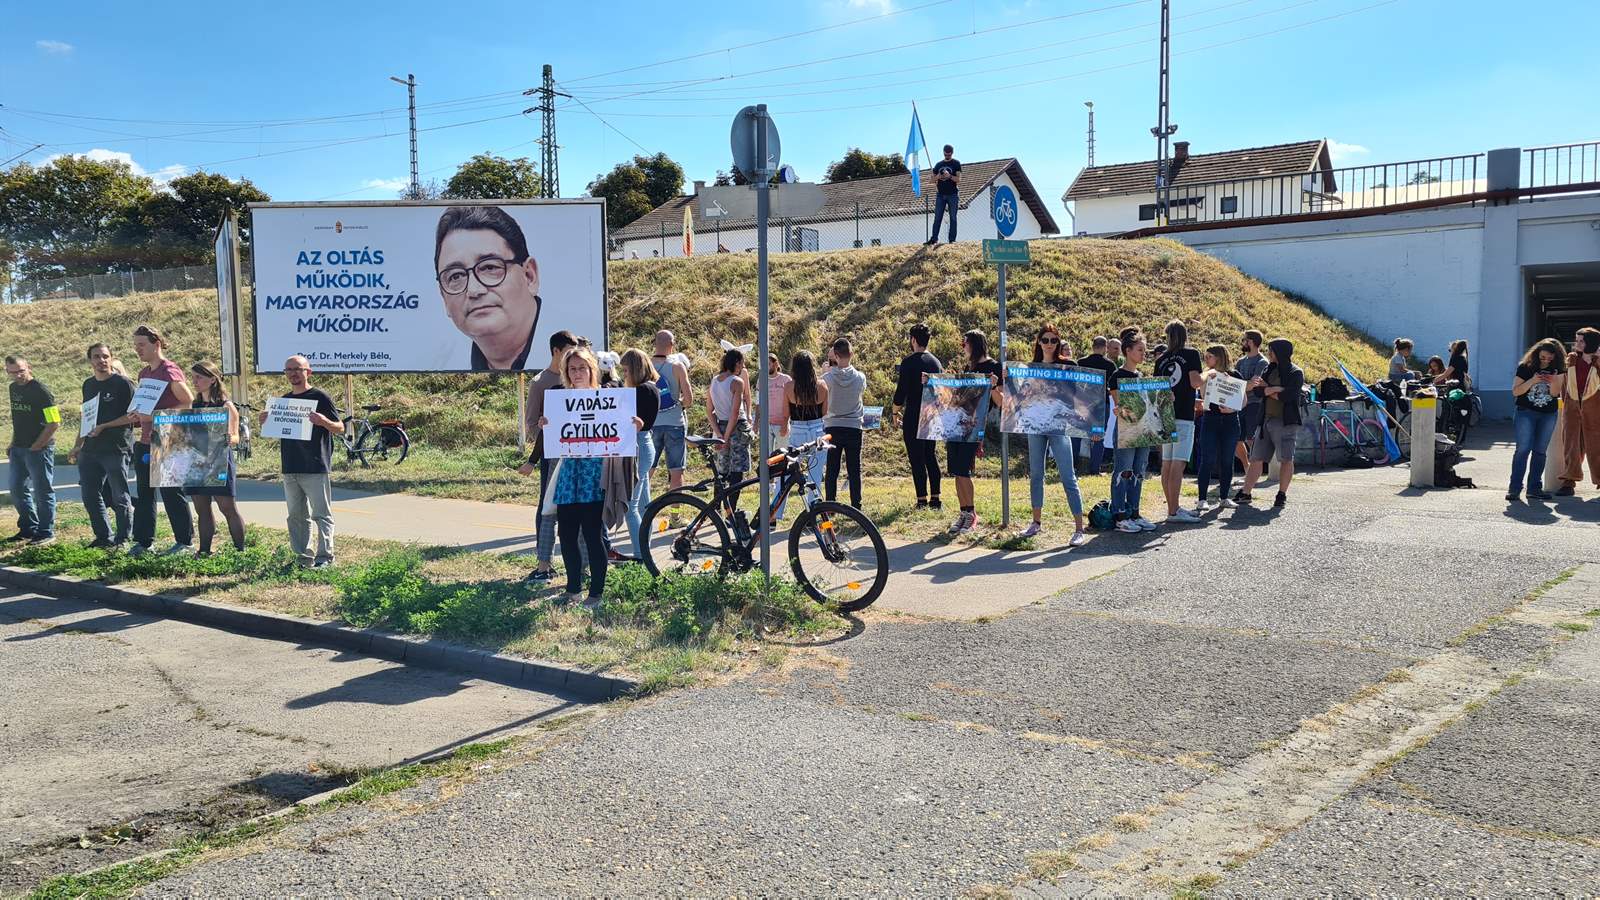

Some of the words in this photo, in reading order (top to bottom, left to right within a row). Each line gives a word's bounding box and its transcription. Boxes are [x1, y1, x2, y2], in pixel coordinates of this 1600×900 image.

[296, 250, 321, 266] AZ
[327, 246, 384, 265] OLTÁS
[296, 269, 390, 290] MŰKÖDIK,
[265, 291, 419, 310] MAGYARORSZÁG
[297, 314, 389, 333] MŰKÖDIK.
[320, 352, 332, 360] Dr.
[334, 352, 368, 361] Merkely
[370, 352, 392, 361] Béla,
[1009, 368, 1051, 378] HUNTING
[1065, 372, 1103, 383] MURDER
[565, 390, 617, 412] VADÁSZ
[160, 414, 188, 423] VADÁSZAT
[190, 412, 226, 422] GYILKOSSÁG
